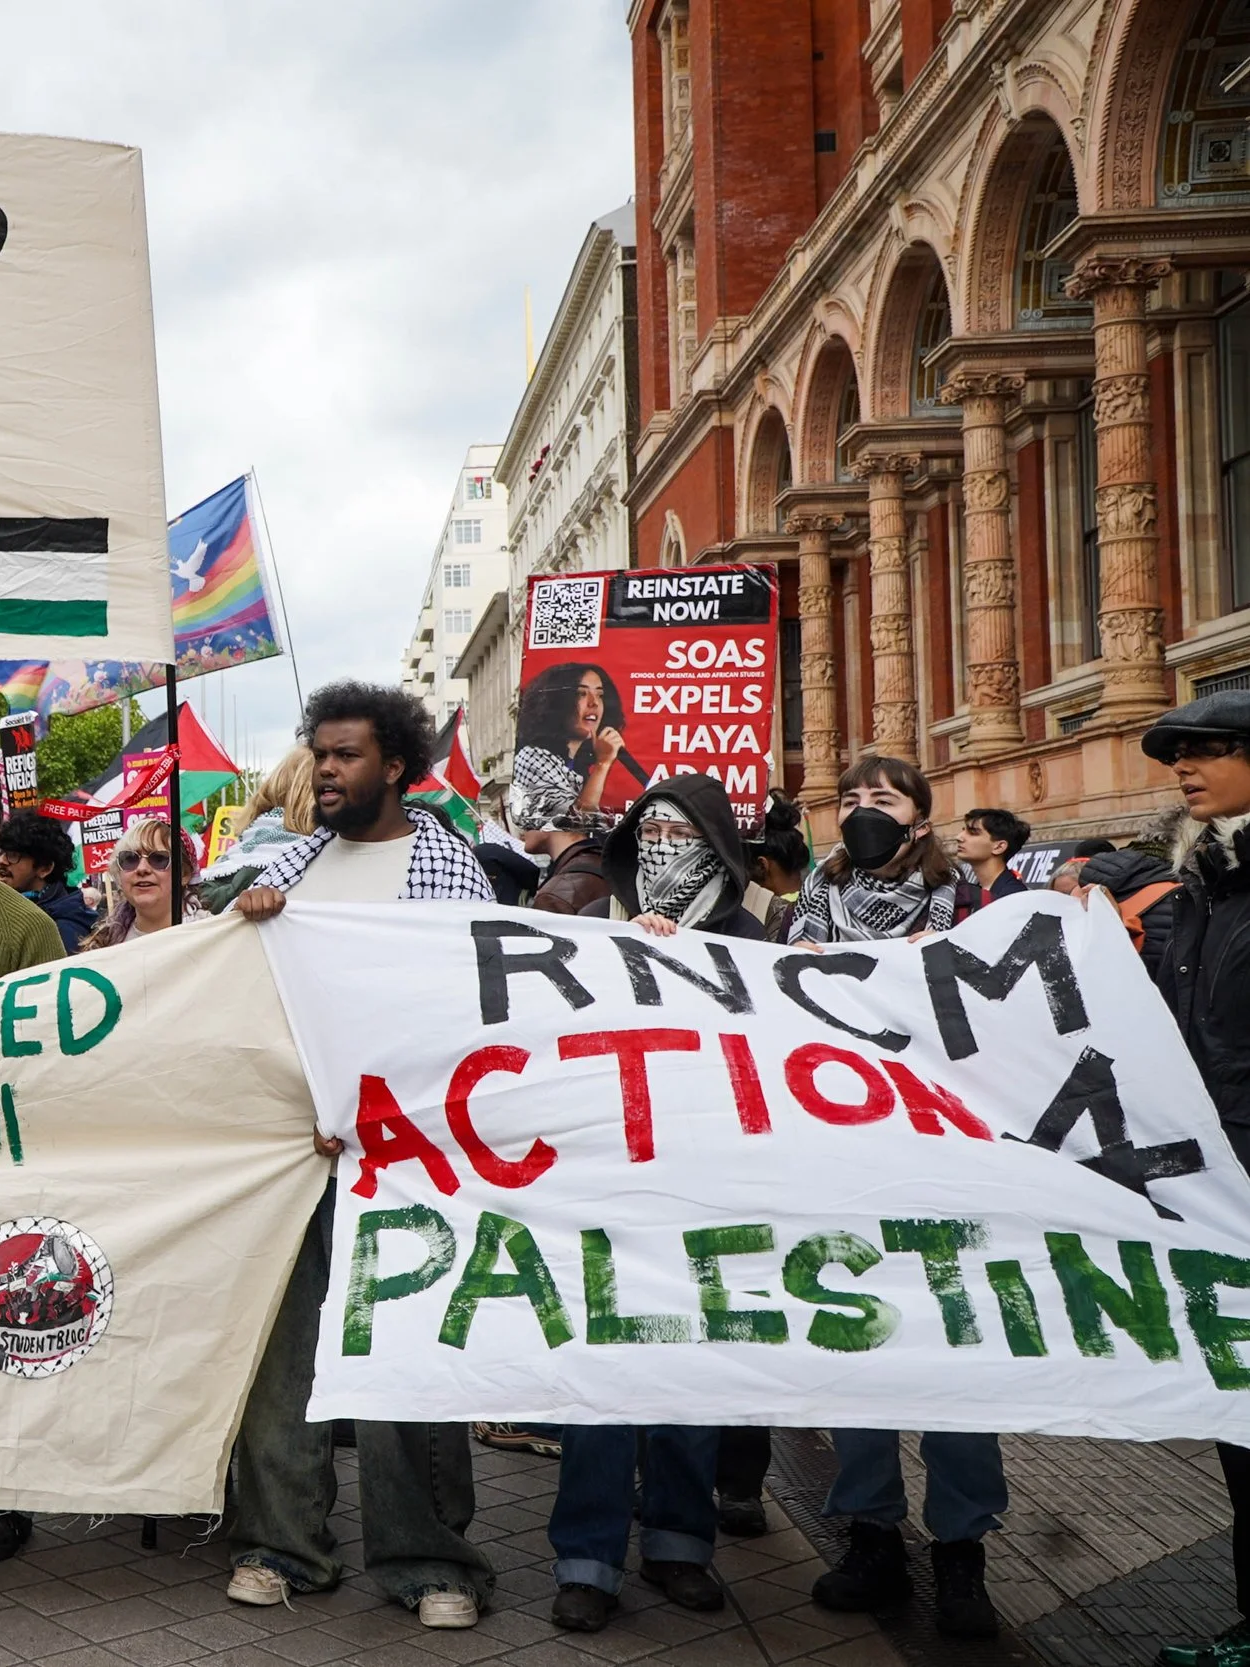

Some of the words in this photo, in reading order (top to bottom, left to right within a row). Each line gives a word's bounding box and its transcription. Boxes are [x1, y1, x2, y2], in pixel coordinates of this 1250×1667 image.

[627, 575, 745, 599] REINSTATE
[653, 600, 720, 622] NOW!
[665, 638, 766, 669] SOAS
[633, 684, 763, 714] EXPELS
[662, 724, 761, 754] HAYA
[645, 764, 757, 794] AM
[44, 803, 66, 815] FREE
[731, 802, 756, 816] THE
[1025, 849, 1061, 883] THE
[470, 912, 1092, 1061] RNCM
[350, 1027, 996, 1198] ACTION
[1000, 1046, 1207, 1222] 4
[341, 1203, 1250, 1392] PALESTINE
